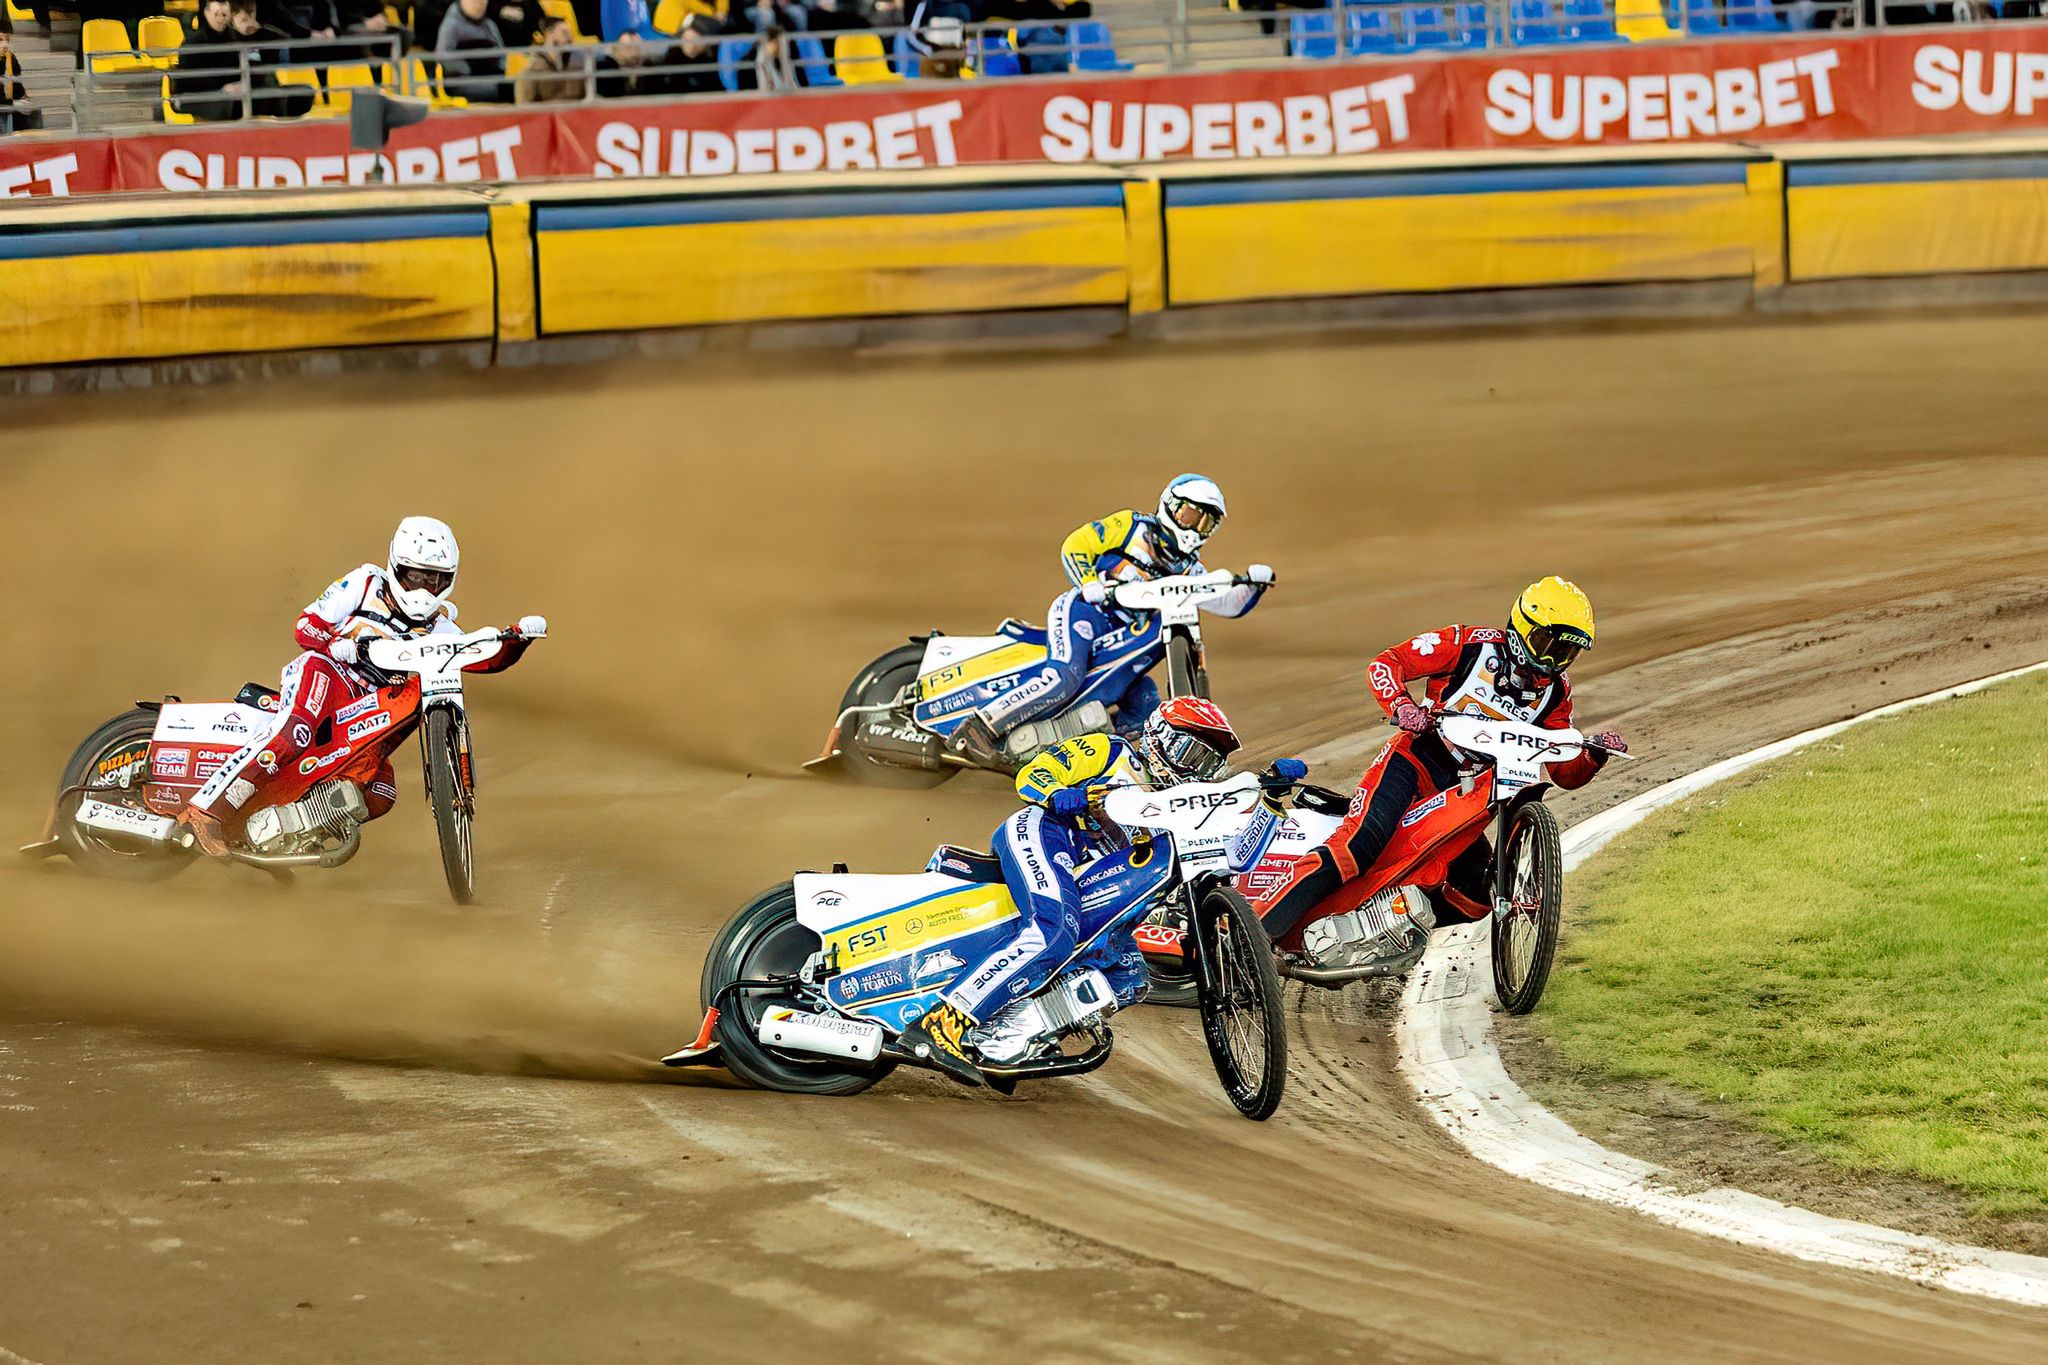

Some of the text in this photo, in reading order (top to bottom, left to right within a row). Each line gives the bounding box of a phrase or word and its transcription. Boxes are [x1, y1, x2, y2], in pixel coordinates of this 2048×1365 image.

[1911, 44, 2048, 115] SUP
[1484, 48, 1840, 140] SUPERBET
[1040, 73, 1415, 163] SUPERBET
[593, 99, 963, 178] SUPERBET
[1160, 584, 1216, 596] PRES
[419, 643, 482, 657] PRES
[928, 665, 964, 689] FST
[1489, 693, 1530, 722] PRES
[212, 723, 248, 733] PRES
[348, 713, 390, 736] SAATZ
[1500, 731, 1562, 755] PRES
[156, 763, 187, 776] TEAM
[1508, 769, 1538, 780] PLEWA
[1169, 792, 1239, 813] PRES
[1188, 837, 1221, 847] PLEWA
[816, 897, 842, 907] PGE
[848, 925, 888, 952] FST
